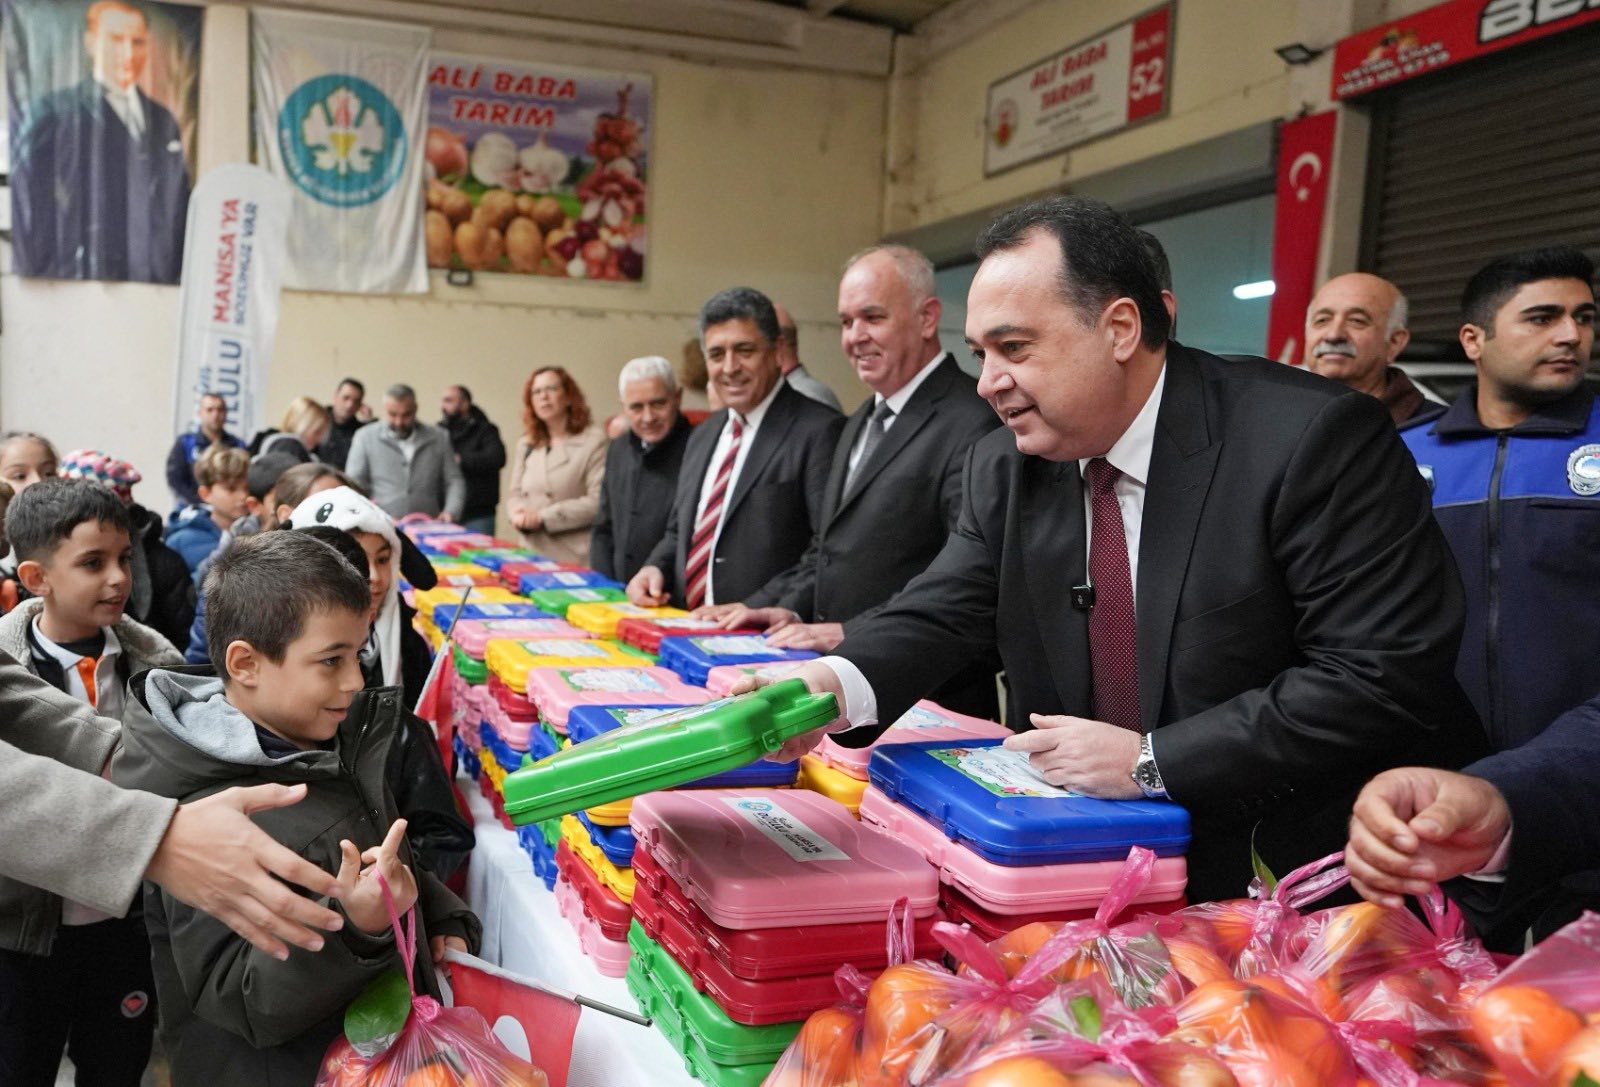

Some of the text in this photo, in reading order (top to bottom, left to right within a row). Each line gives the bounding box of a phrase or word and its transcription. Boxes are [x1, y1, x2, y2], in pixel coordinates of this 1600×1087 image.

[1478, 0, 1600, 42] BE
[1062, 41, 1107, 76] BABA
[430, 63, 577, 99] ALİ BABA
[1041, 74, 1094, 111] TARIM
[1130, 57, 1163, 100] 52
[452, 99, 556, 126] TARIM
